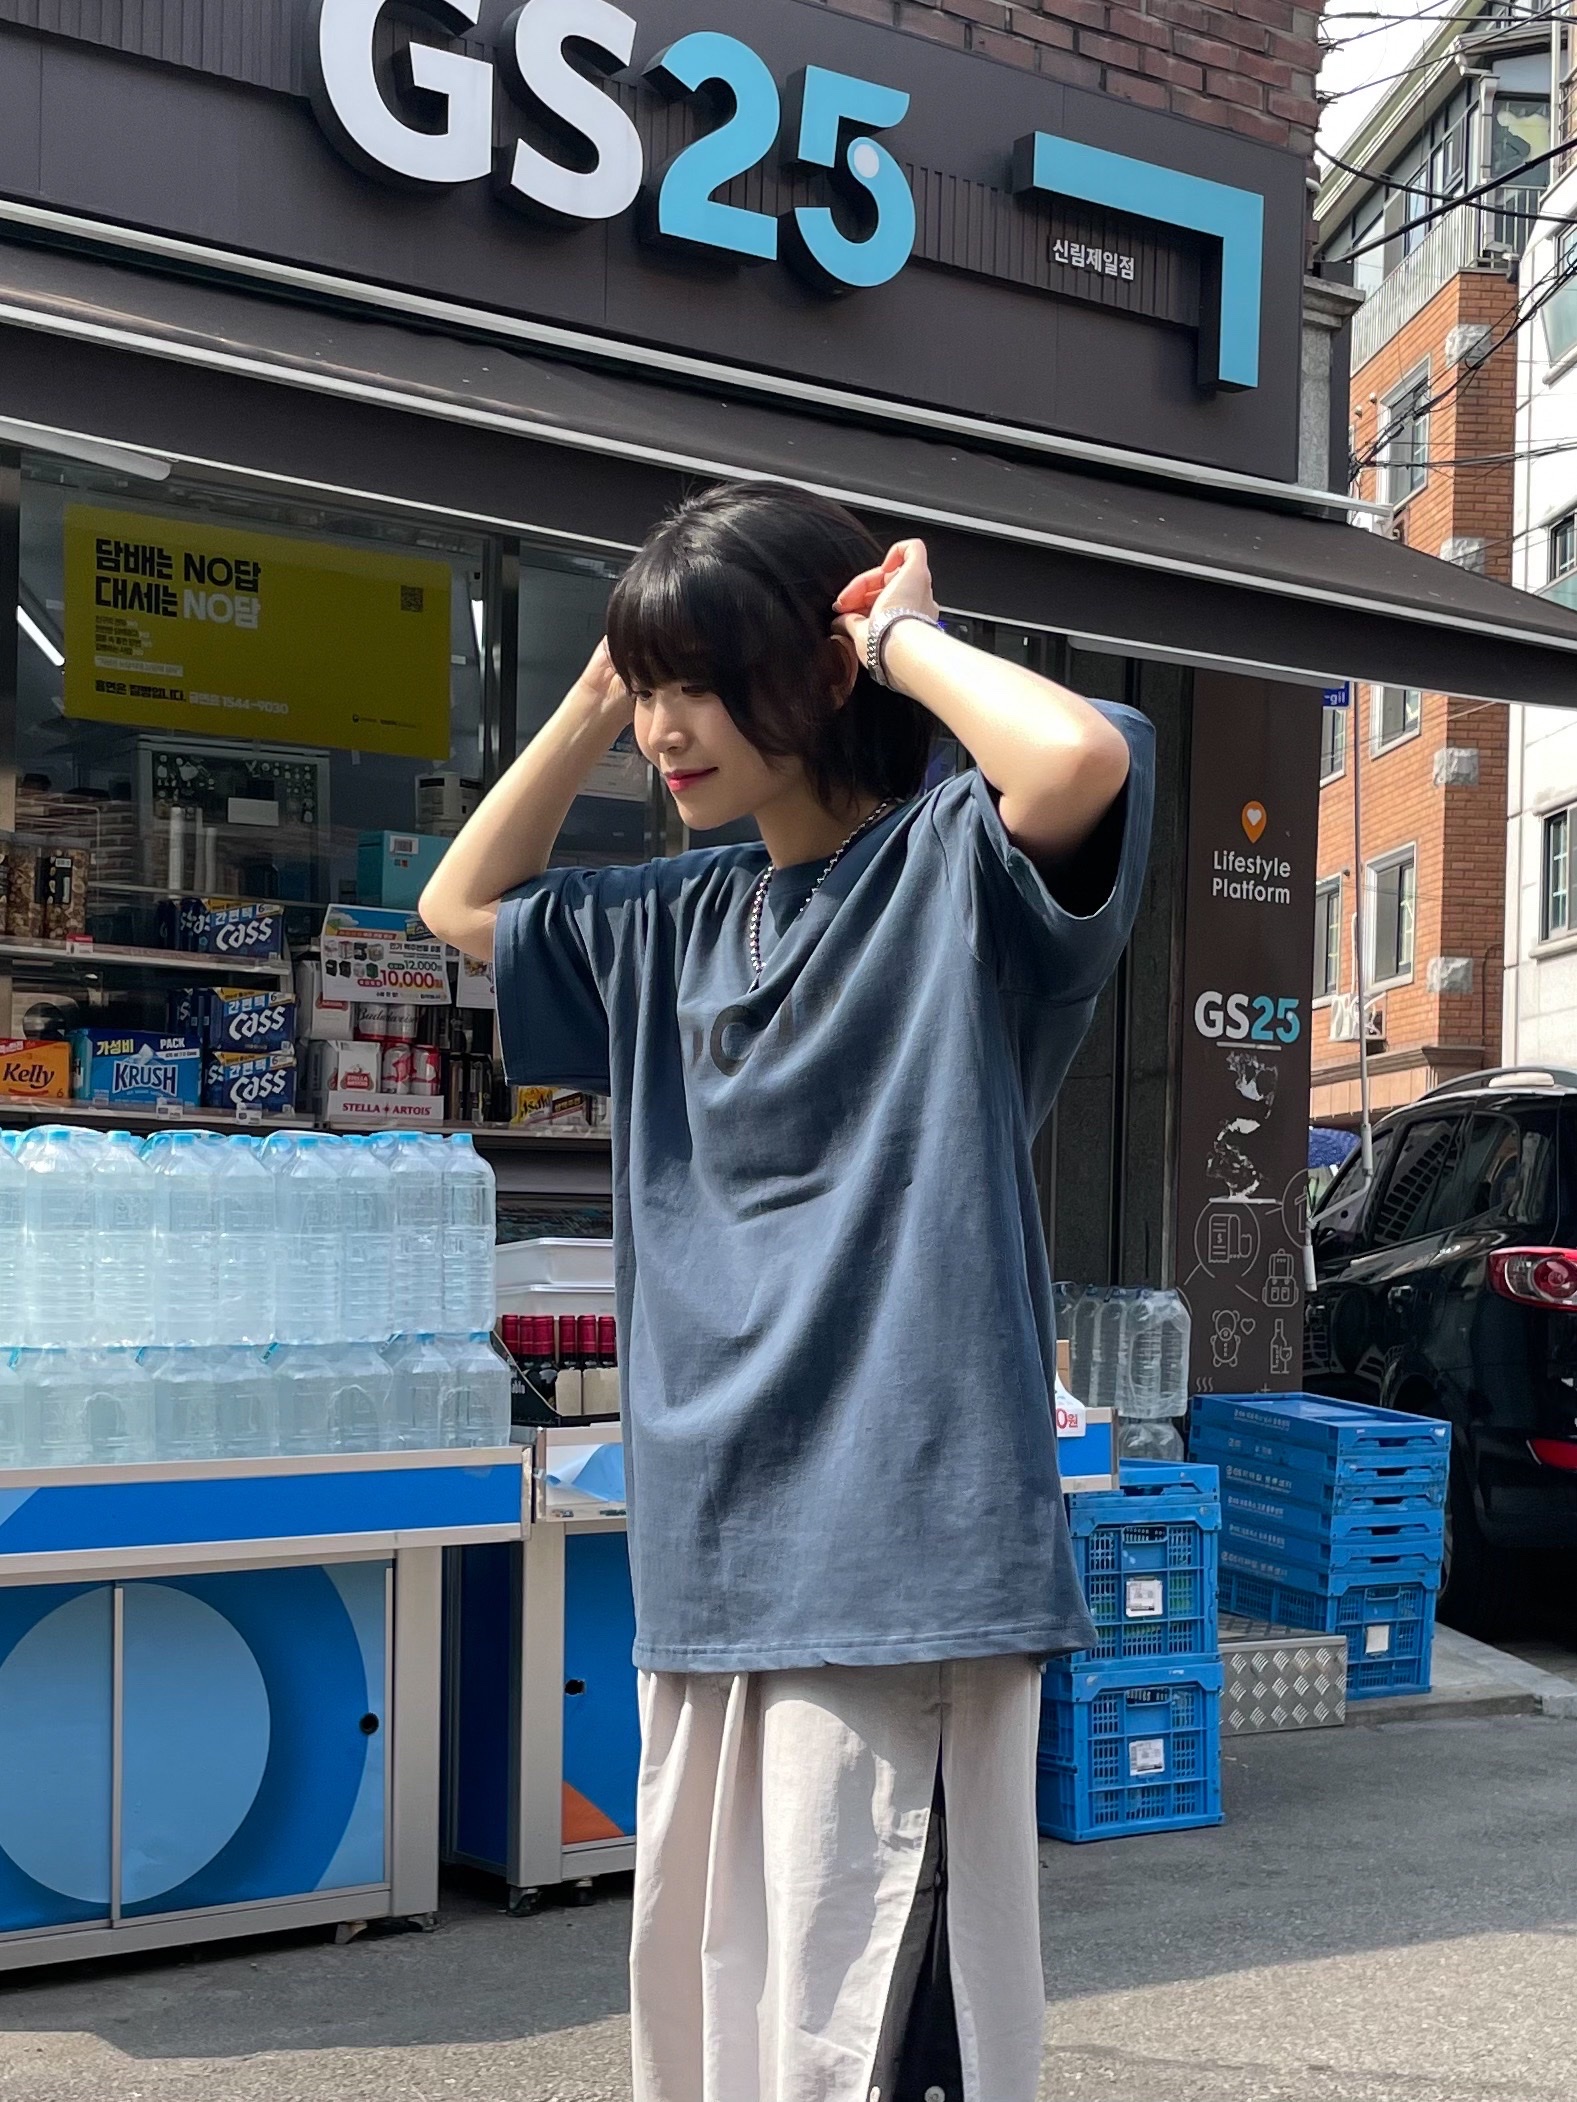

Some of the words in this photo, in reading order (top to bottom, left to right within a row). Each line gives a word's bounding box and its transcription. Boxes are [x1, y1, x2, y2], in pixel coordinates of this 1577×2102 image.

[317, 0, 917, 287] GS25
[1053, 239, 1135, 280] 신림제일점
[96, 538, 174, 580] 담배는
[184, 552, 261, 593] NO답
[95, 575, 178, 618] 대세는
[183, 588, 262, 630] NO담
[222, 695, 289, 715] 1544-9030
[1324, 691, 1345, 705] -gil
[1213, 850, 1291, 881] Lifestyle
[1212, 877, 1291, 905] Platform
[1194, 990, 1300, 1043] GS25
[96, 1038, 135, 1056] 가성비
[159, 1037, 186, 1051] PACK
[2, 1061, 55, 1090] Kelly
[113, 1061, 178, 1097] KRUSH
[342, 1102, 380, 1113] STELLA
[392, 1104, 432, 1116] ARTOIS
[1057, 1407, 1078, 1430] 0원
